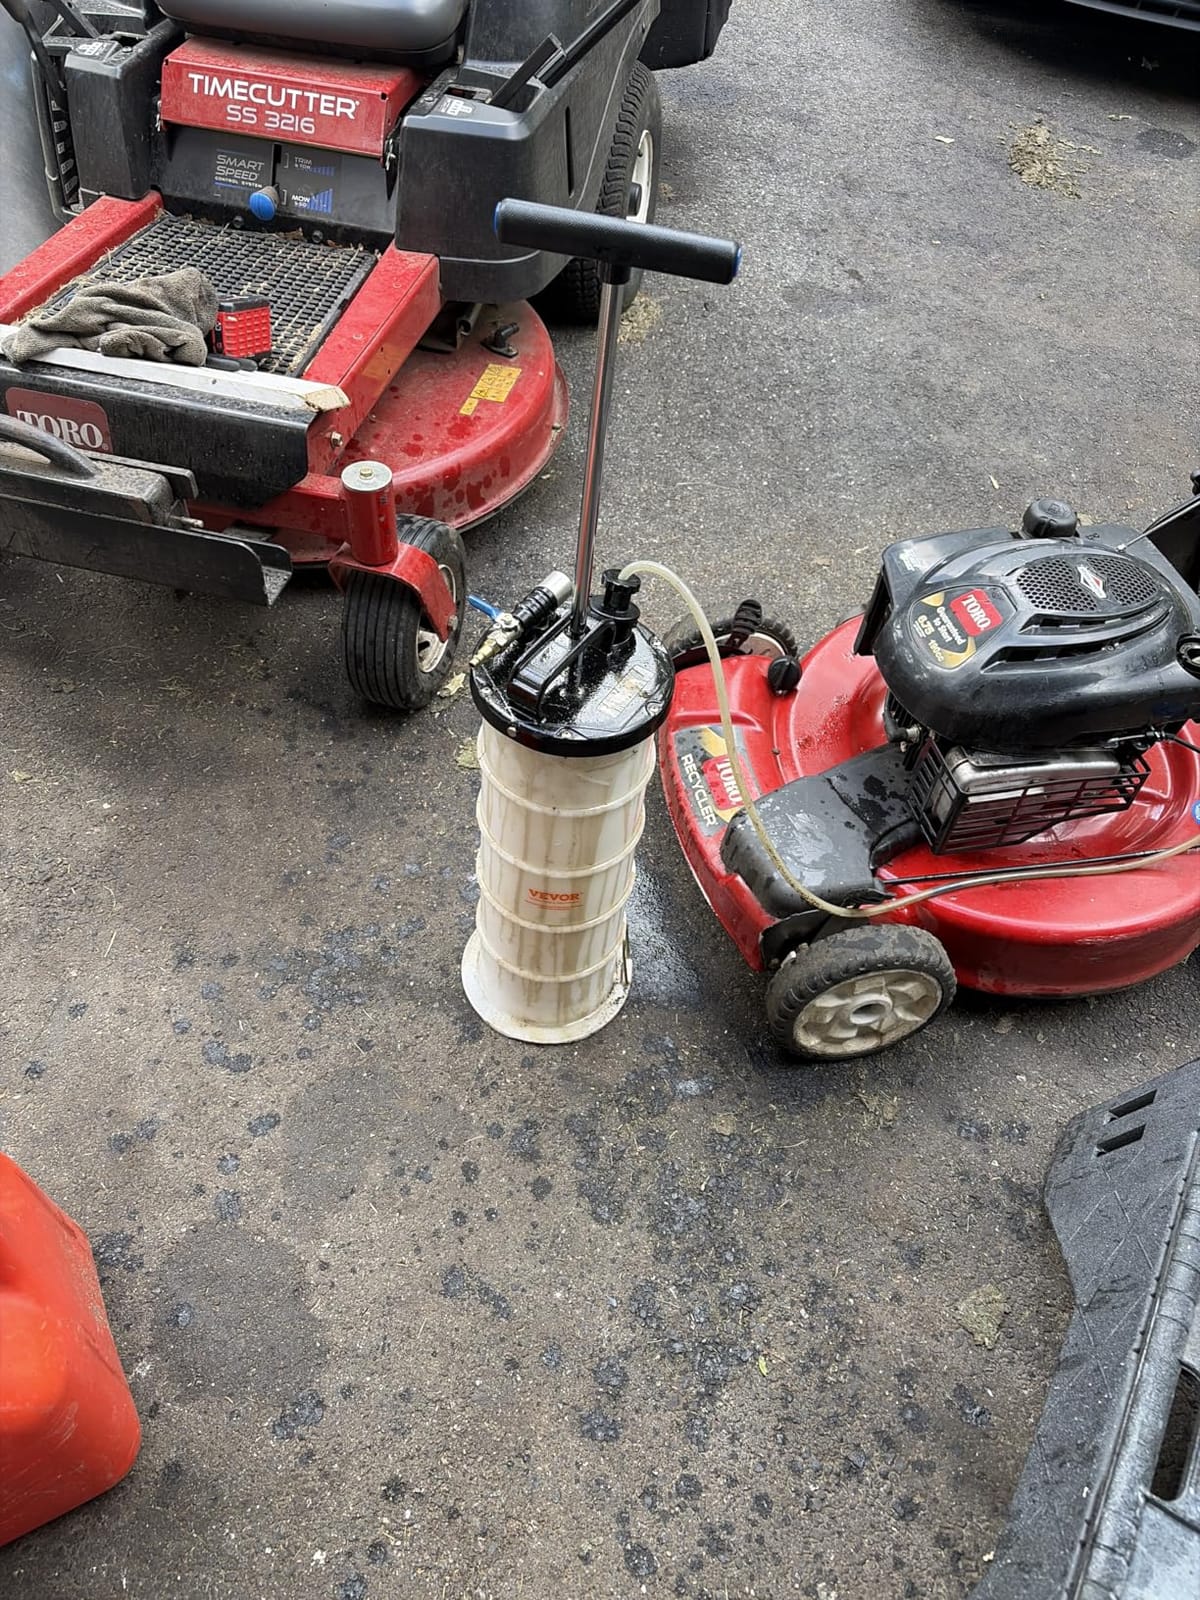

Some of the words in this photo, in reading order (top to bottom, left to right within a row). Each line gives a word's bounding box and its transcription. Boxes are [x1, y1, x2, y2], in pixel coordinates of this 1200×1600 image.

[188, 72, 357, 120] TIMECUTTER
[226, 104, 257, 124] SS
[264, 109, 315, 134] 3216
[215, 154, 265, 171] SMART
[215, 165, 258, 181] SPEED
[937, 606, 966, 645] Guaranteed
[961, 594, 991, 629] TORO
[938, 625, 952, 642] Start
[681, 753, 717, 826] RECYCLER
[528, 888, 580, 901] VEVOR
